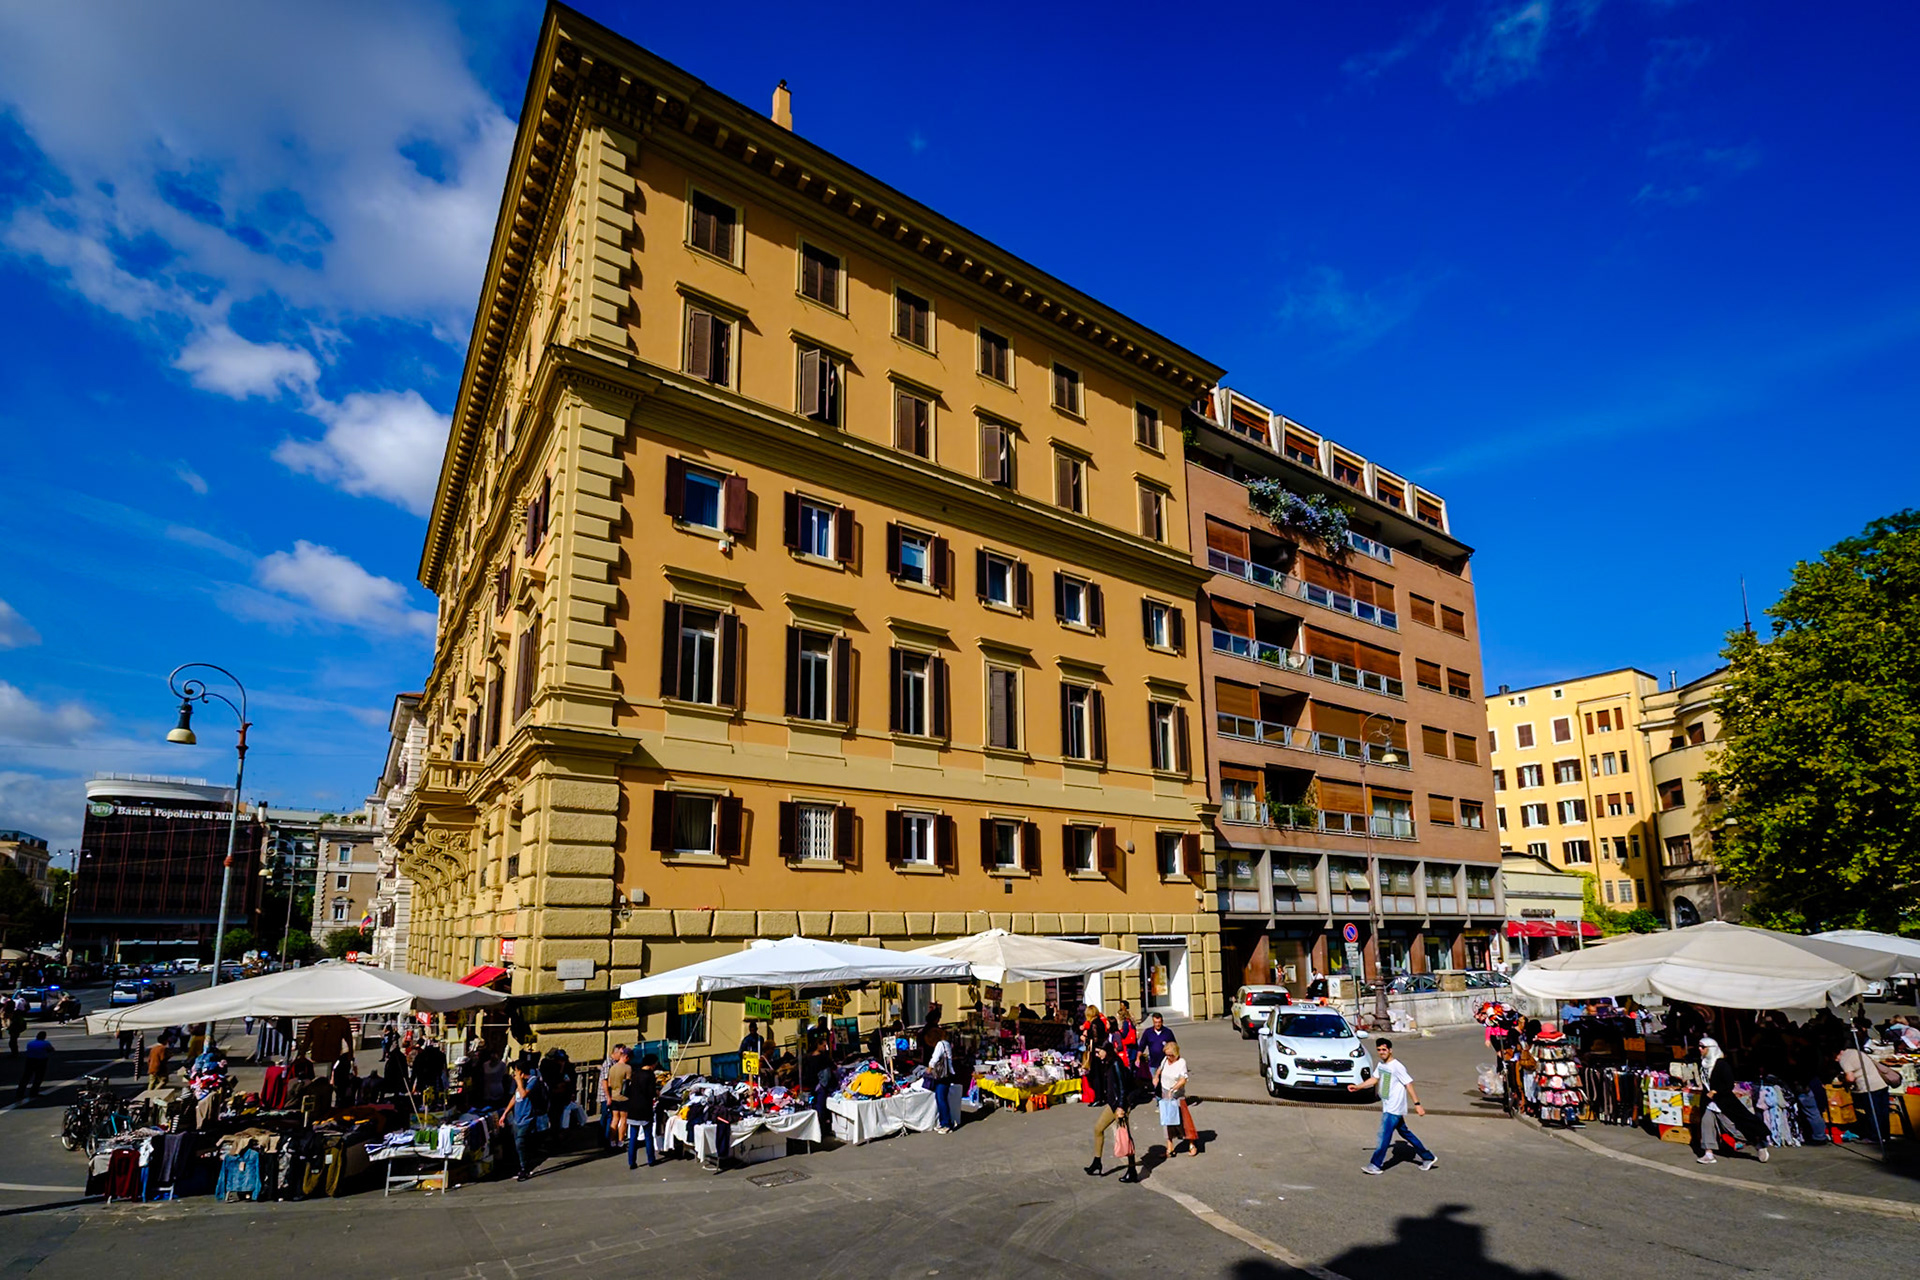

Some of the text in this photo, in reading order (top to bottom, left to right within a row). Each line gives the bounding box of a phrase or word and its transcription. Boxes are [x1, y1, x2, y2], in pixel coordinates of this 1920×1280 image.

[117, 806, 252, 822] Banca Popolare di Milno
[745, 1001, 771, 1015] INTIMO
